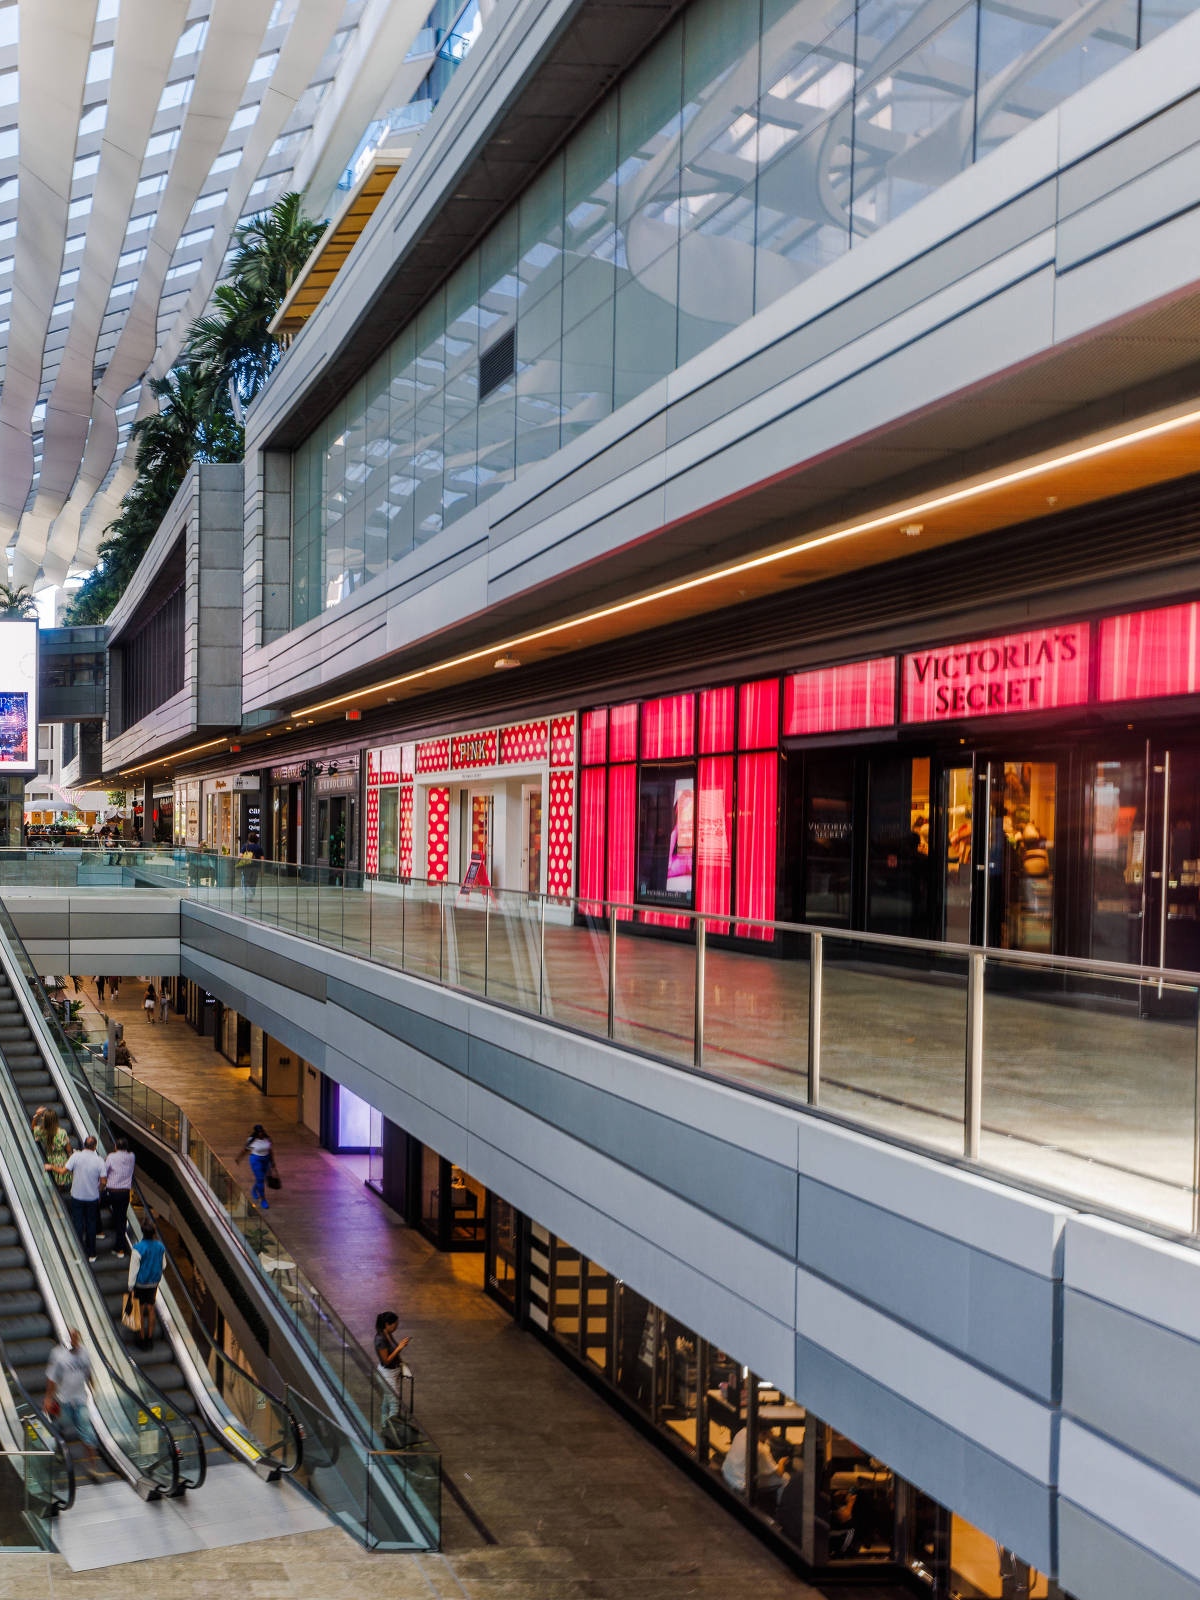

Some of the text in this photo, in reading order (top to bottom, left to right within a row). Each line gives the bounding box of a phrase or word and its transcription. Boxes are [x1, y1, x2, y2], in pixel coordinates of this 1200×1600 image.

[913, 633, 1077, 683] VICTORIA'S
[935, 676, 1042, 714] SECRET
[460, 740, 486, 762] PINK
